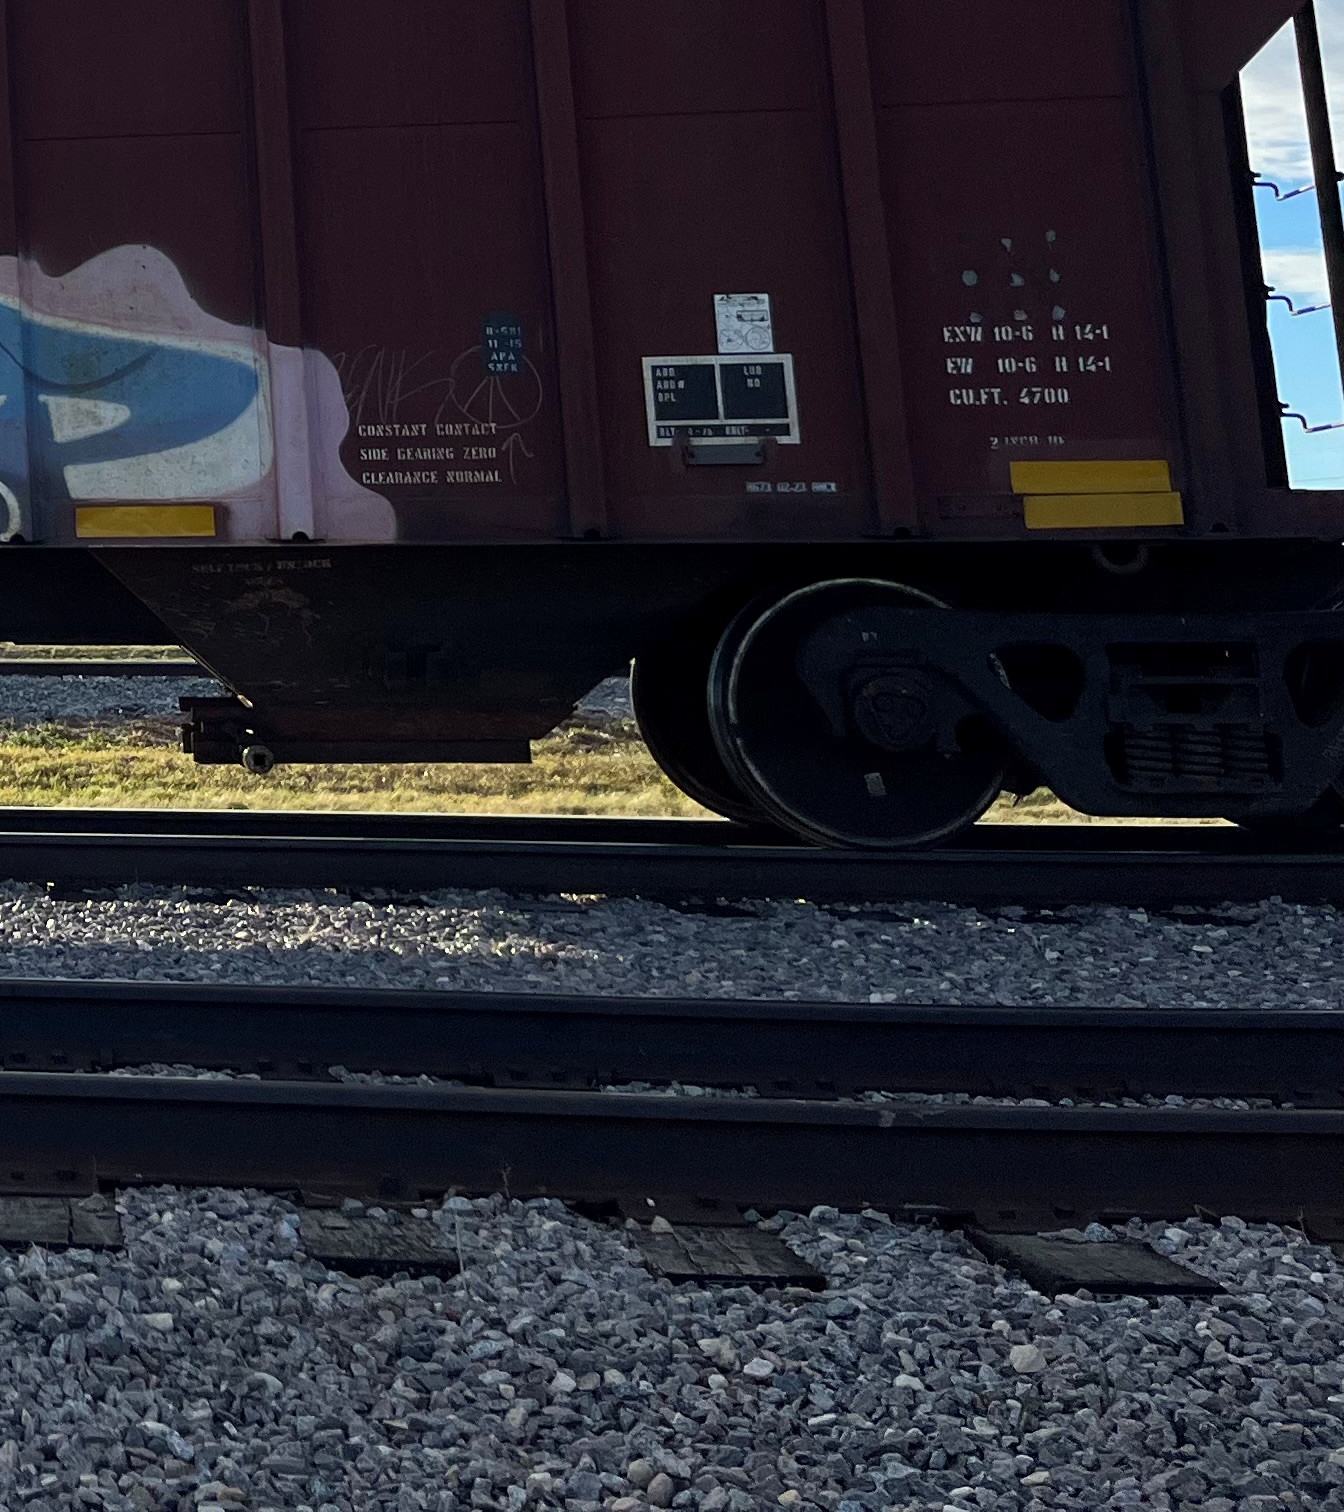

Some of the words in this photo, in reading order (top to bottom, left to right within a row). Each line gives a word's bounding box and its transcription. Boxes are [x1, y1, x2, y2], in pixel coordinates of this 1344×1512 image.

[943, 326, 983, 342] EXW
[993, 325, 1034, 342] 10-6
[946, 357, 973, 375] EW
[997, 356, 1037, 373] 10-6
[1019, 387, 1070, 404] 4700
[358, 422, 428, 437] CONSTANT
[435, 422, 498, 437] CONTACT
[360, 447, 389, 461] SIDE
[463, 445, 497, 460] ZERO
[362, 470, 439, 486] CLEARANCE
[446, 469, 502, 484] NORMAL
